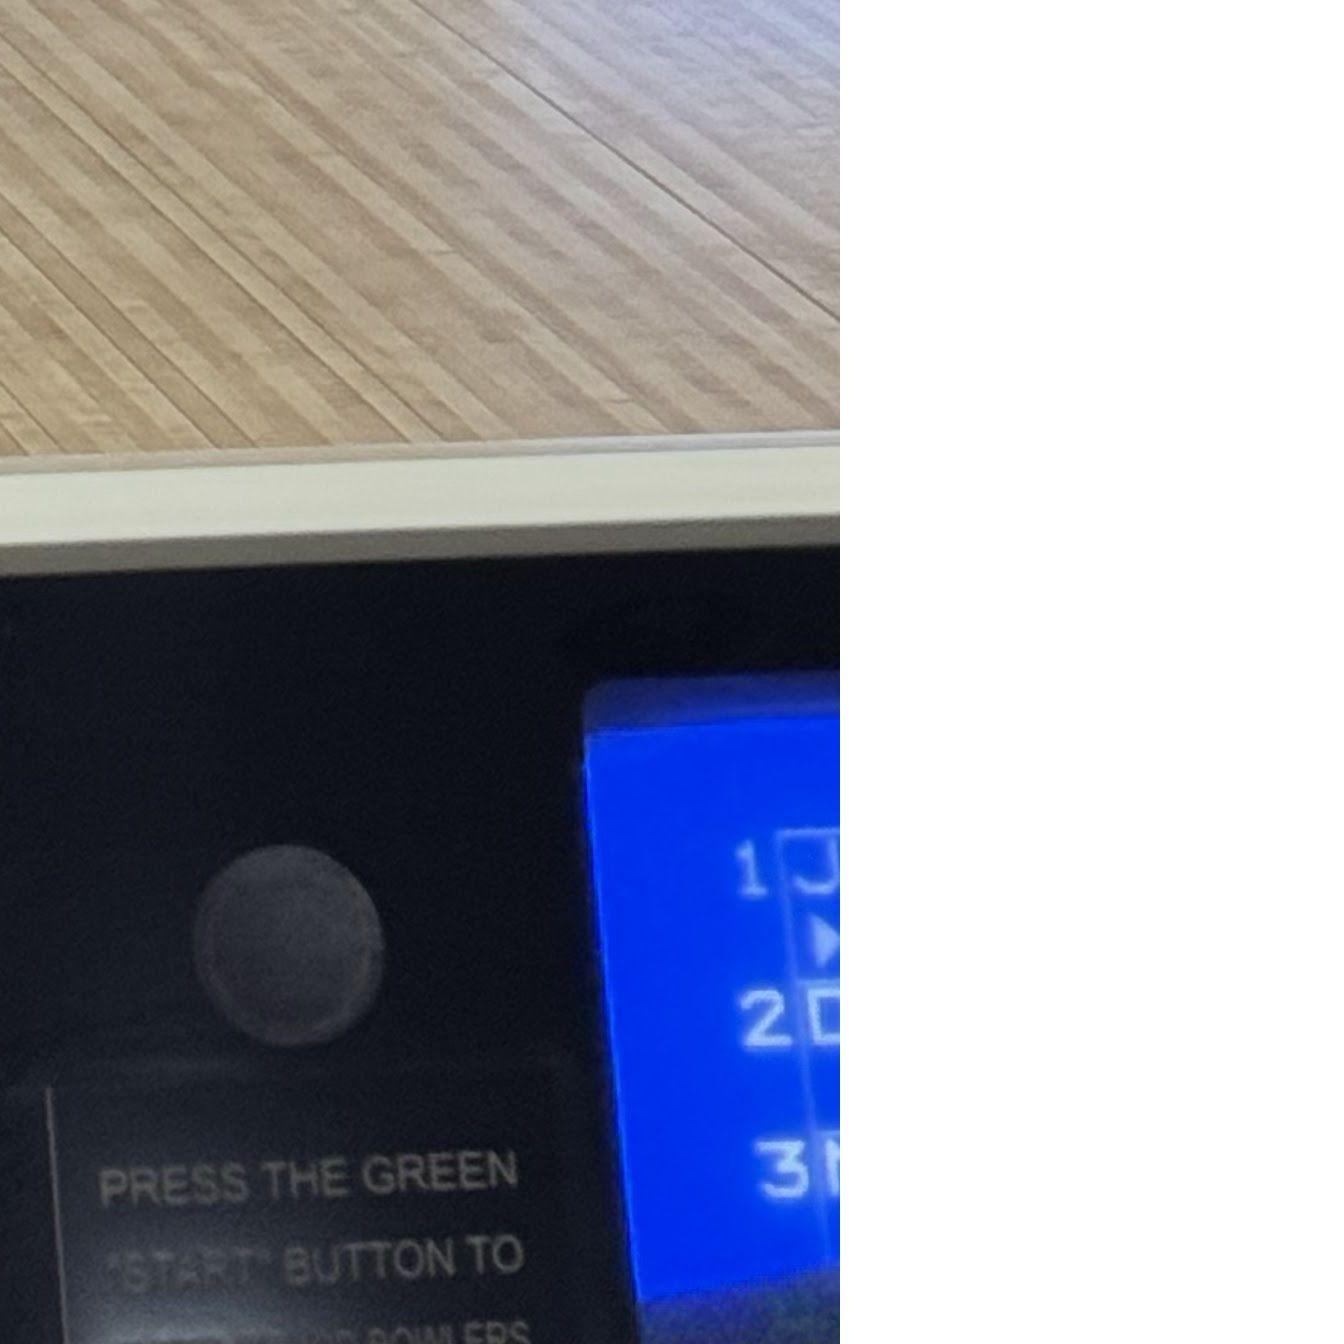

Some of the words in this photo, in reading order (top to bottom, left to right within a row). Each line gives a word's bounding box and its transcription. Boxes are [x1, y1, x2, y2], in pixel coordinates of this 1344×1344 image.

[736, 838, 768, 897] 1
[740, 988, 794, 1048] 2
[99, 1161, 250, 1208] PRESS
[261, 1157, 350, 1202] THE
[360, 1149, 519, 1195] GREEN
[755, 1139, 810, 1200] 3
[282, 1238, 457, 1286] BUTTON
[465, 1234, 525, 1274] TO
